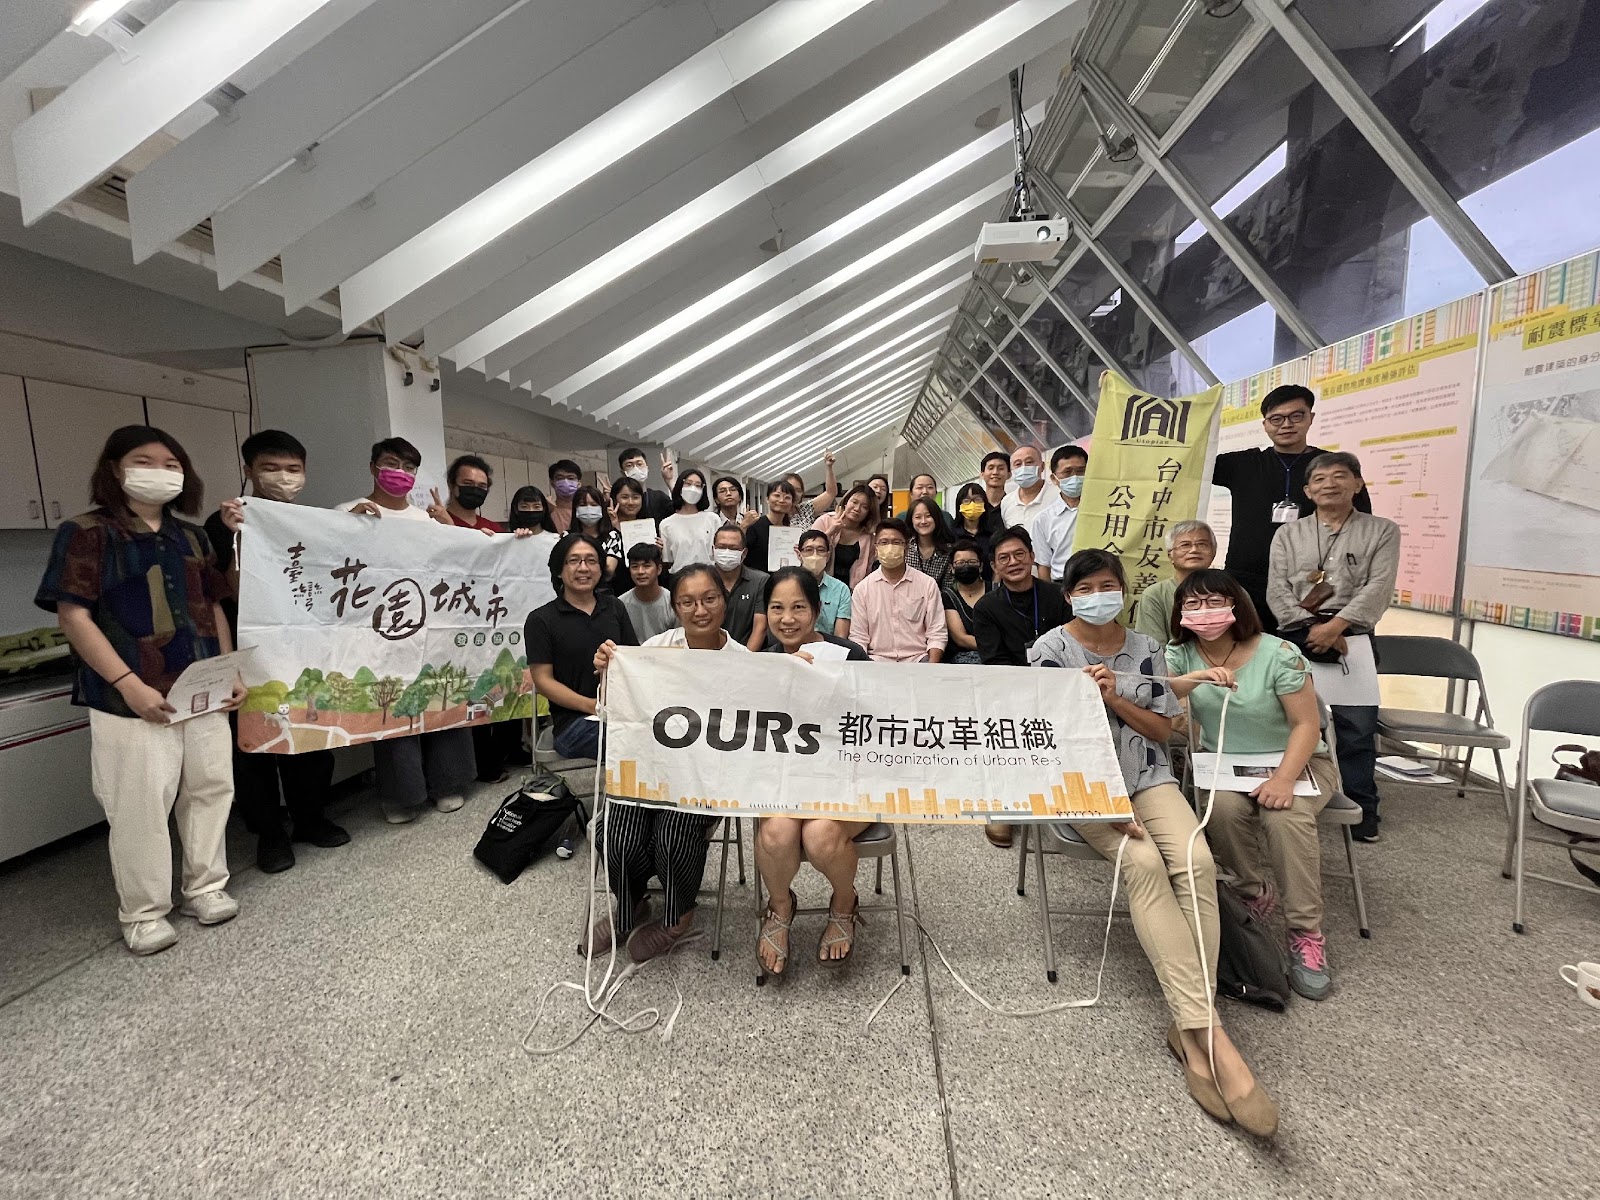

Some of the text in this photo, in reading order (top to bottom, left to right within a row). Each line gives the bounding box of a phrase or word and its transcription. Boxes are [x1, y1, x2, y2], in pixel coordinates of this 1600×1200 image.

[330, 557, 508, 641] 花園城市
[652, 706, 821, 755] OURs
[838, 711, 1057, 751] 都市改革組織
[837, 749, 861, 763] The
[866, 751, 959, 767] Organization
[964, 754, 978, 766] of
[982, 754, 1027, 766] Urban
